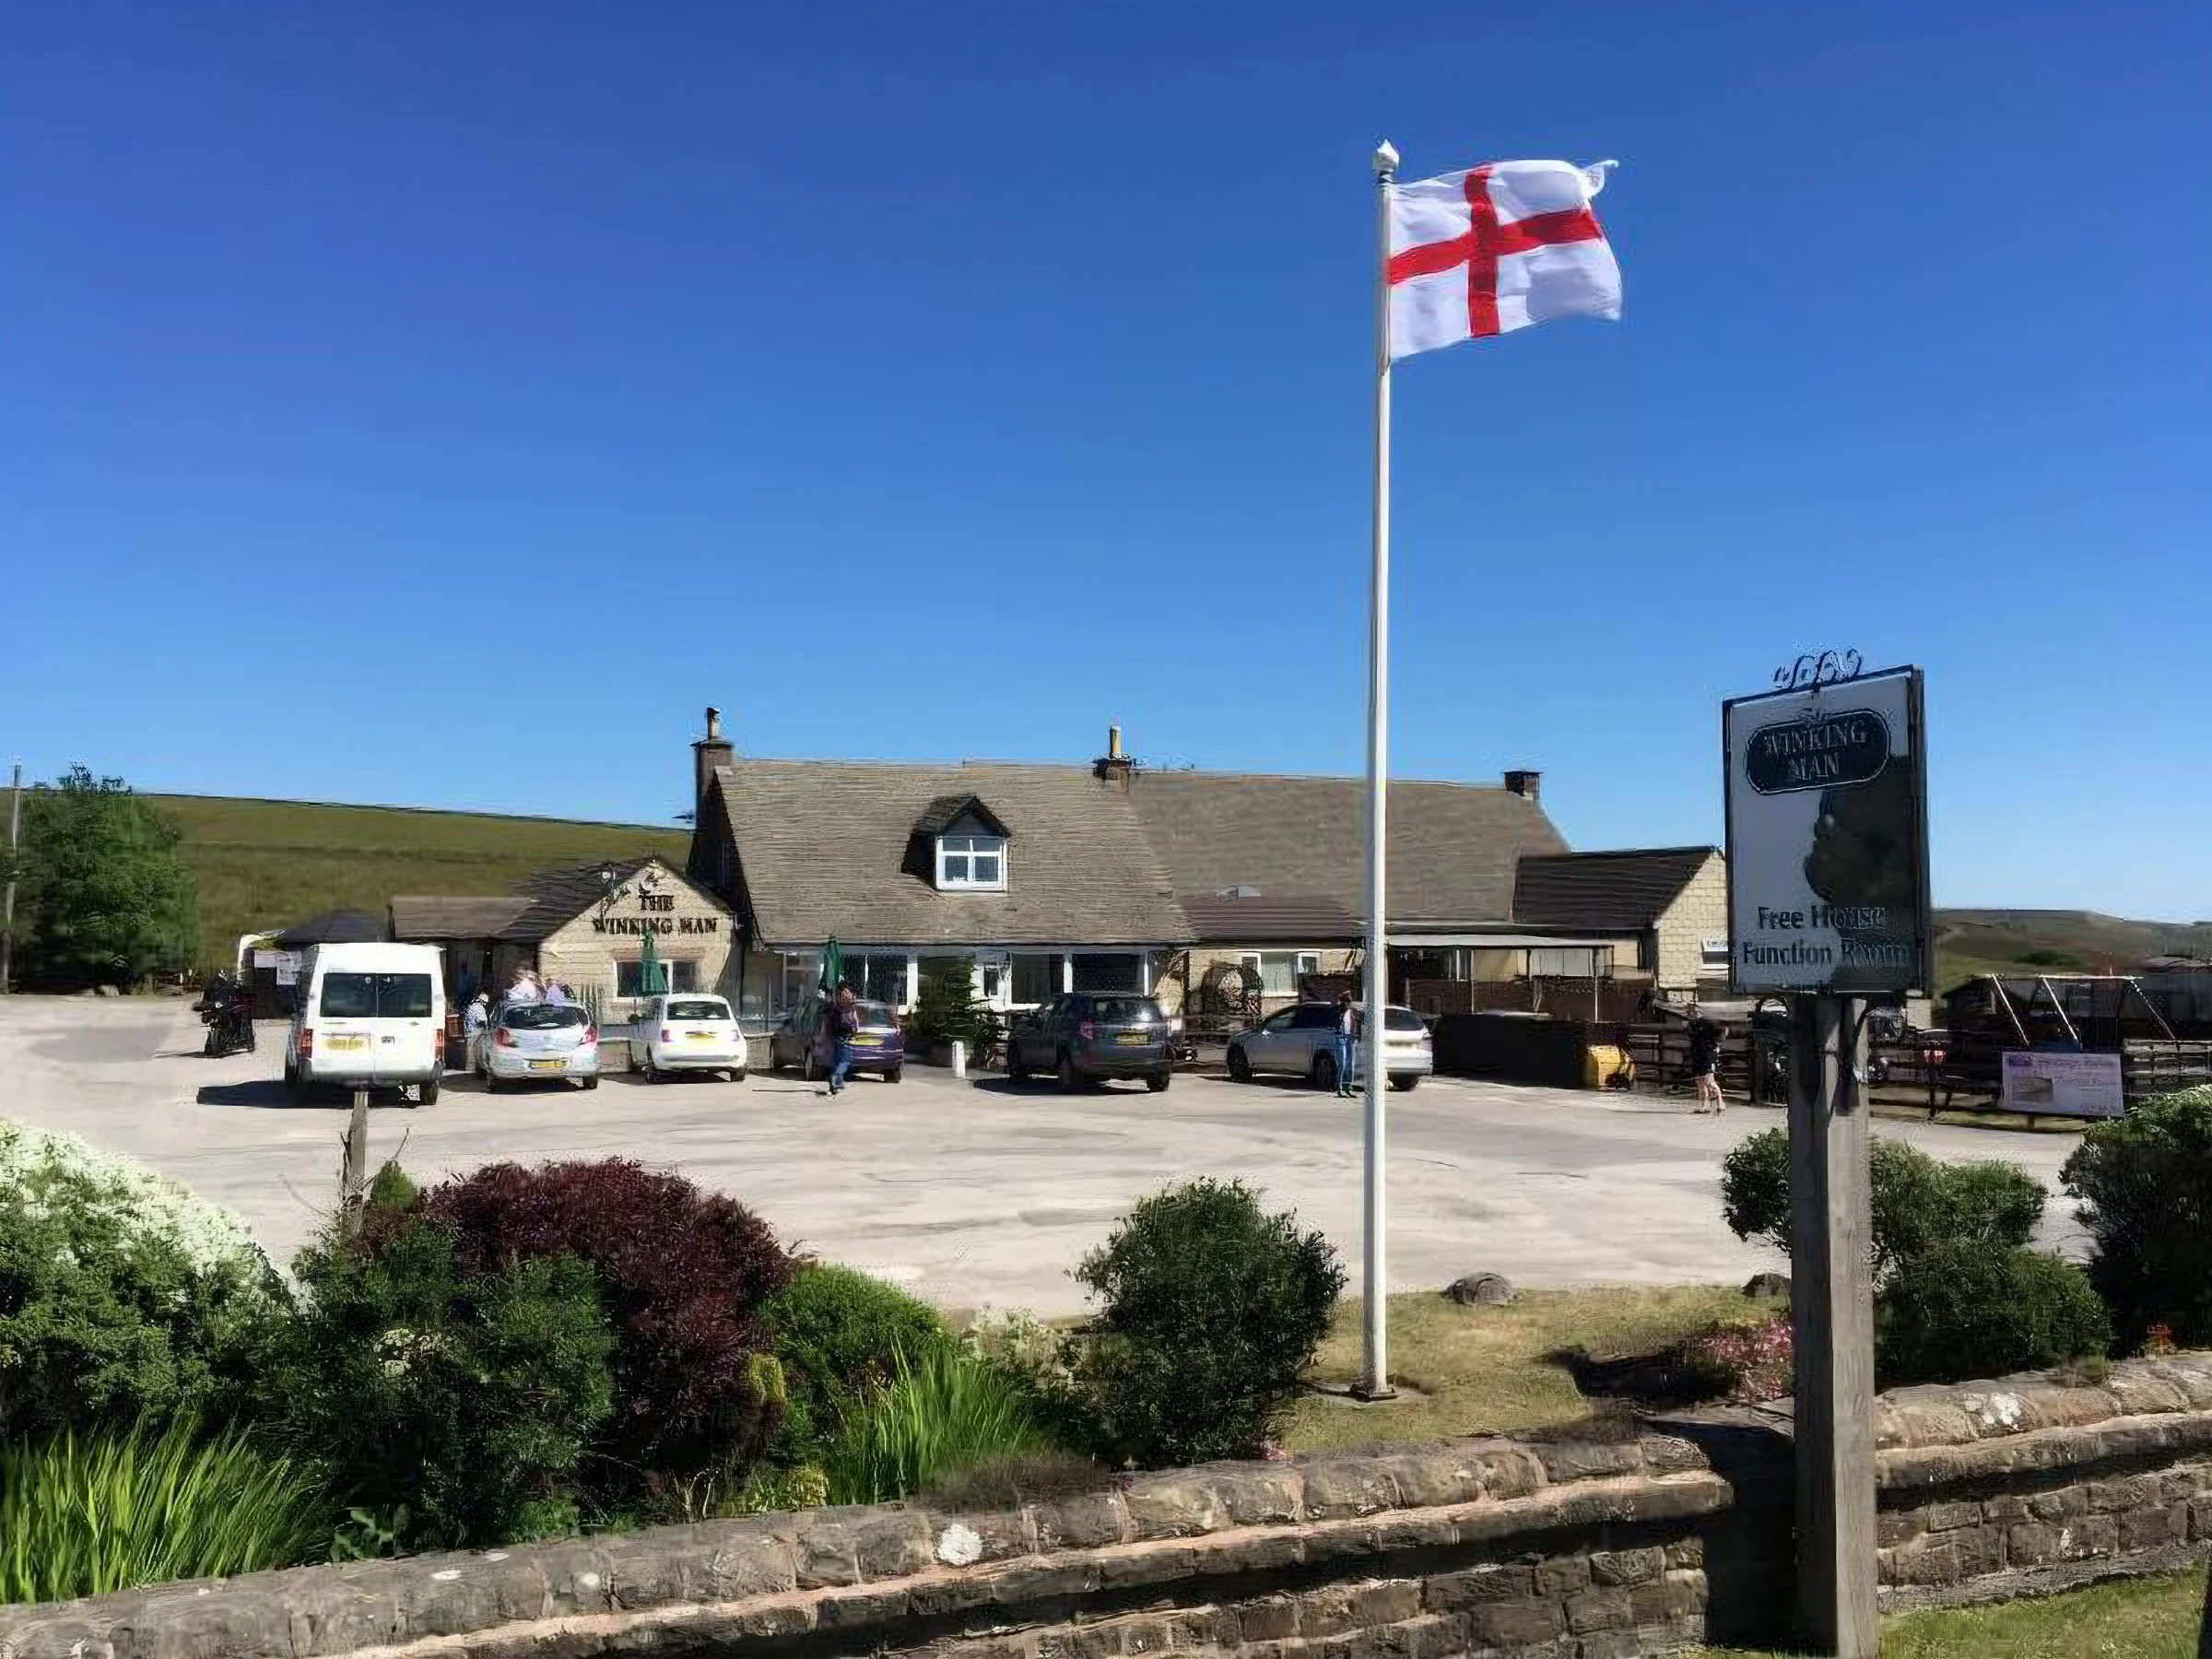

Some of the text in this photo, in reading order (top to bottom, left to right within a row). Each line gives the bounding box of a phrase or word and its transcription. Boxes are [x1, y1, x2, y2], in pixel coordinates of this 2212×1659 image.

[1763, 720, 1867, 755] WINKING
[1788, 752, 1840, 781] MAN
[639, 894, 675, 912] THE
[679, 917, 718, 935] MAN
[1758, 904, 1886, 930] Free House
[1742, 938, 1833, 966] Function
